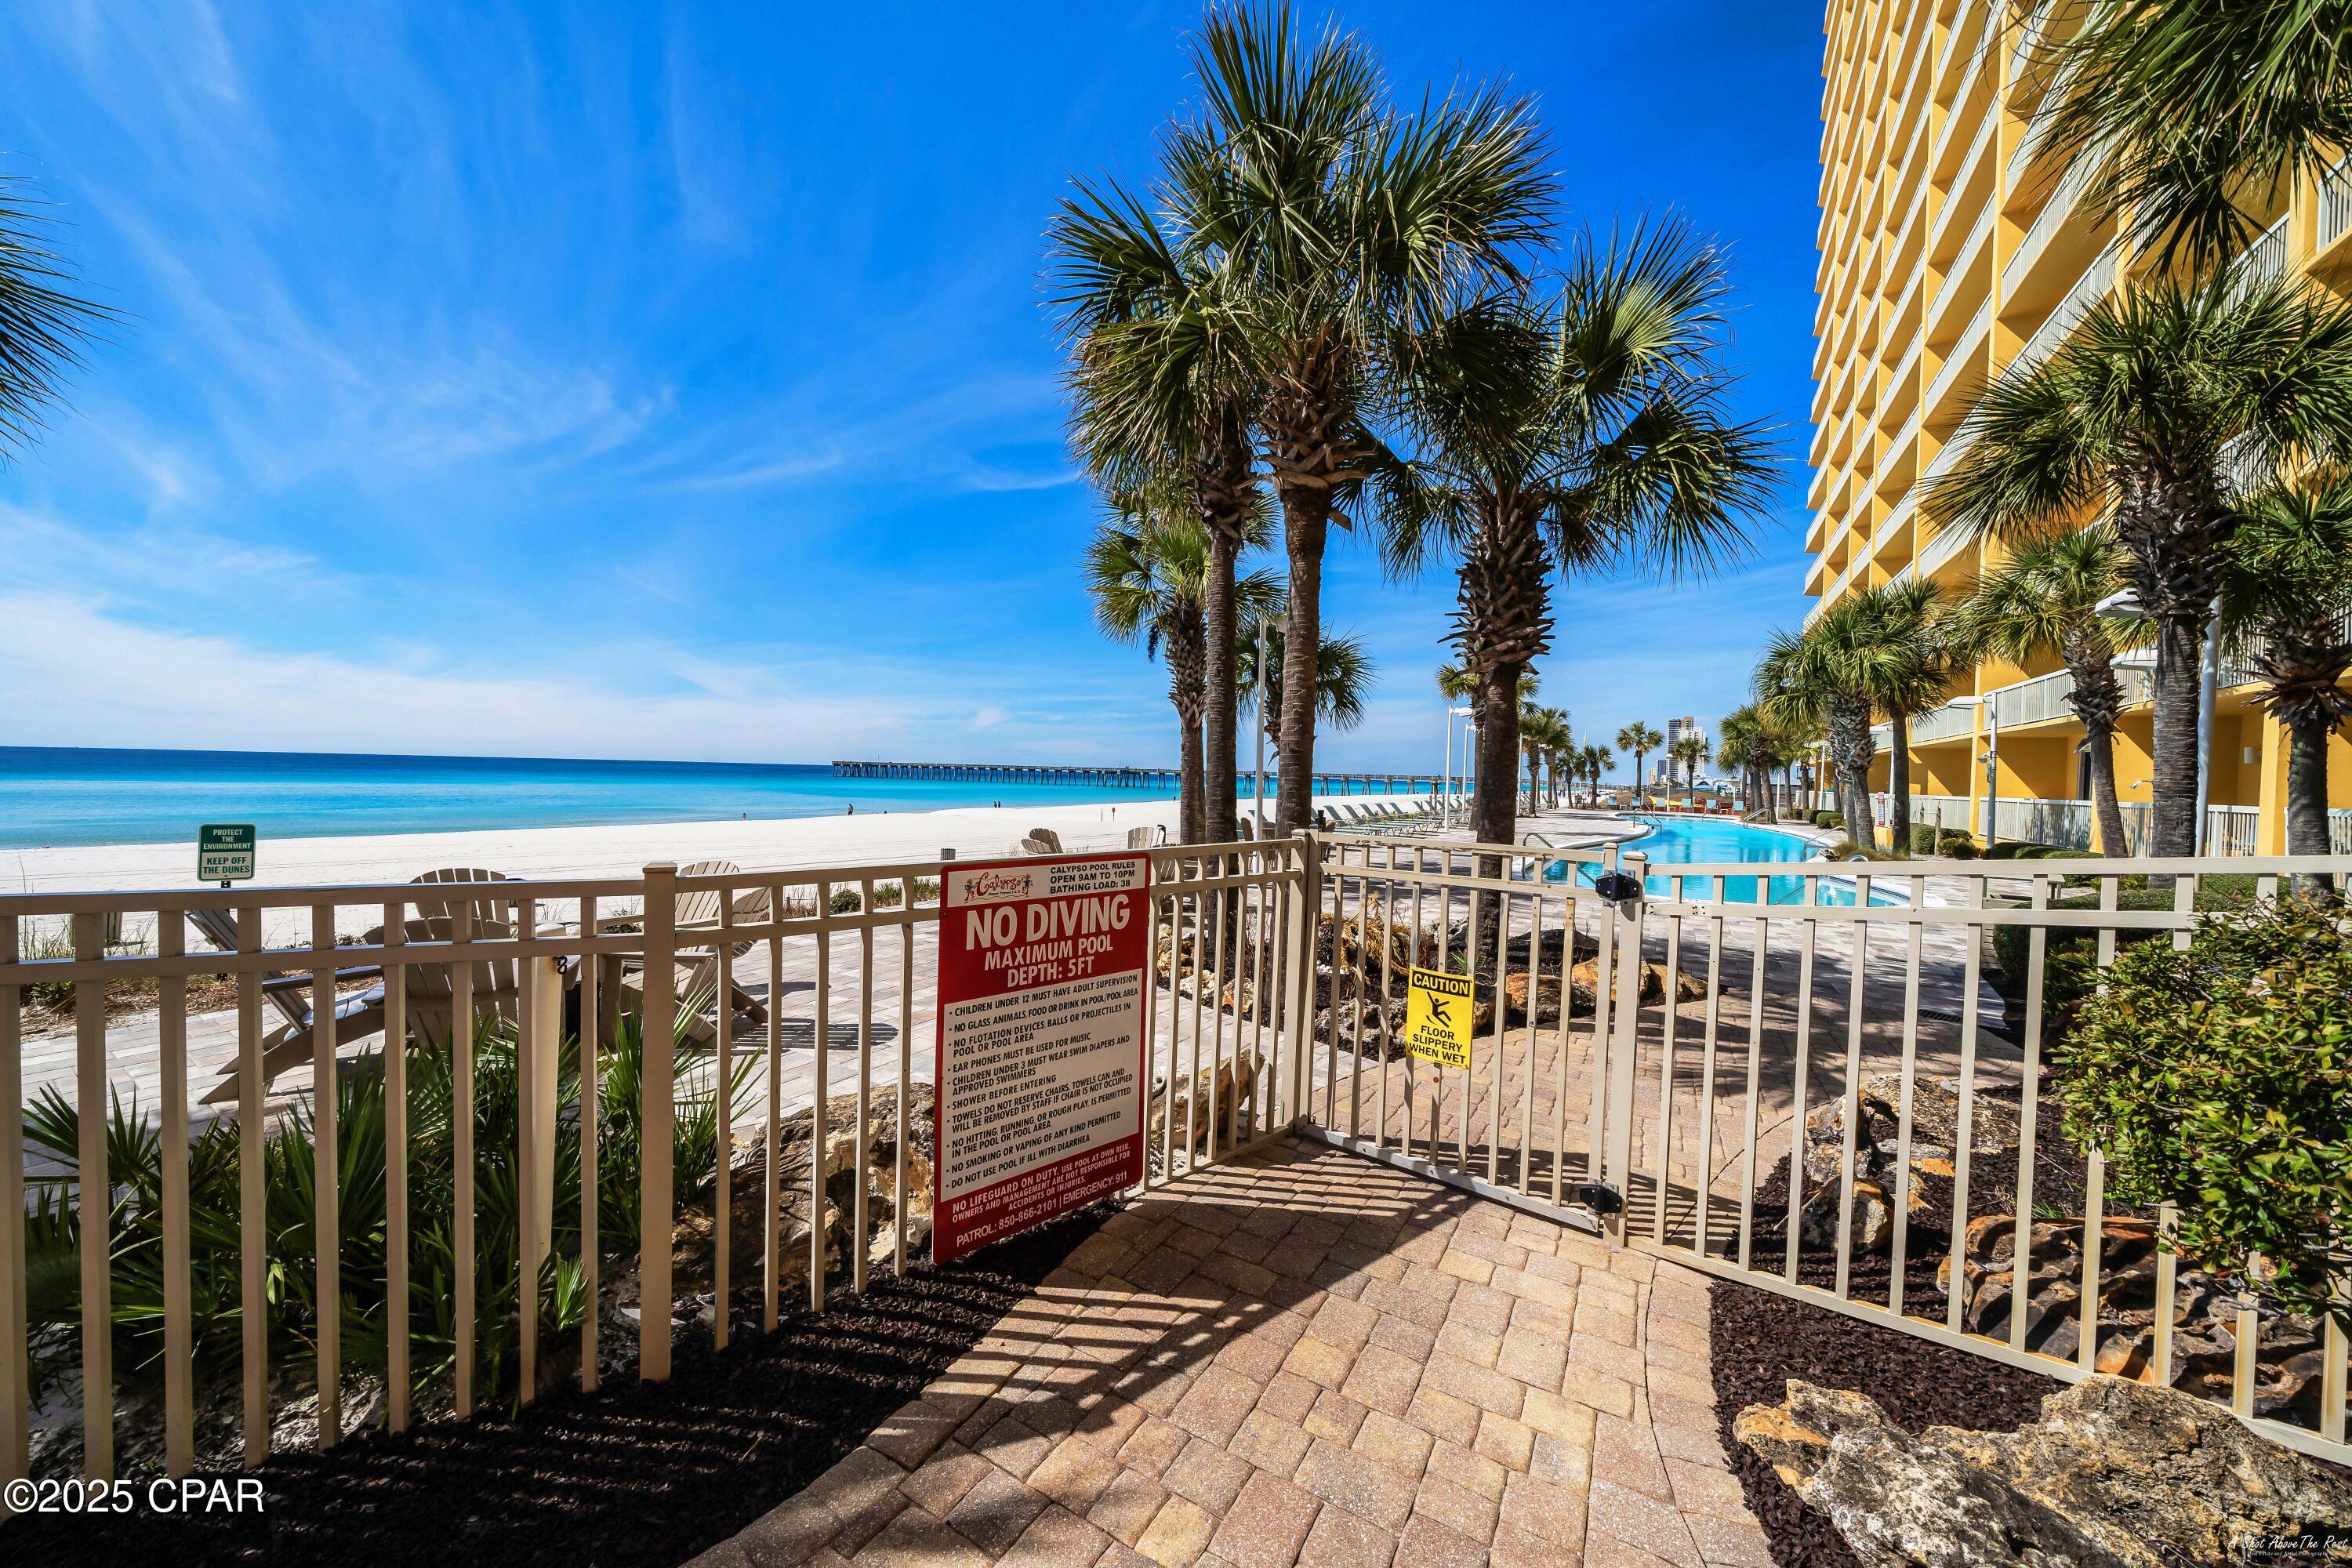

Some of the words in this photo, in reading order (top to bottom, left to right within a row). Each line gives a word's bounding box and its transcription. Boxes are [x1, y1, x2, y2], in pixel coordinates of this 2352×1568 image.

[1051, 875, 1075, 884] OPEN
[1051, 884, 1091, 894] BATHING
[967, 906, 1017, 950] NO
[1026, 895, 1130, 942] DIVING
[985, 940, 1073, 971] MAXIMUM
[1078, 935, 1112, 955] POOL
[1007, 962, 1062, 987] DEPTH:
[1068, 956, 1094, 976] 5FT
[955, 1002, 992, 1016] CHILDREN
[996, 997, 1019, 1008] UNDER
[1032, 990, 1051, 1001] MUST
[1054, 987, 1070, 997] HAVE
[1073, 982, 1094, 993] ADULT
[1096, 974, 1138, 989] SUPERVISION
[1414, 974, 1468, 994] CAUTION
[954, 1038, 966, 1048] NO
[969, 1029, 1011, 1044] FLOTATION
[1047, 1016, 1067, 1027] BALLS
[1082, 1004, 1121, 1019] PROJECTILES
[955, 1023, 965, 1033] NO
[1029, 1007, 1047, 1017] FOOD
[1059, 1000, 1079, 1011] DRINK
[1089, 991, 1122, 1004] POOL/POOL
[1123, 988, 1138, 997] AREA
[953, 1062, 968, 1073] EAR
[971, 1054, 1001, 1068] PHONES
[1004, 1048, 1023, 1061] MUST
[1025, 1047, 1034, 1055] BE
[1036, 1040, 1053, 1052] USED
[1056, 1038, 1068, 1047] FOR
[1070, 1033, 1091, 1044] MUSIC
[1413, 1034, 1463, 1052] SLIPPERY
[1421, 1025, 1454, 1040] FLOOR
[953, 1069, 991, 1086] CHILDREN
[993, 1062, 1018, 1076] UNDER
[1027, 1055, 1047, 1068] MUST
[1048, 1051, 1067, 1062] WEAR
[1069, 1045, 1087, 1057] SWIM
[1090, 1039, 1115, 1051] DIAPERS
[1116, 1036, 1130, 1044] AND
[1409, 1043, 1438, 1058] WHEN
[1443, 1051, 1465, 1064] WET
[953, 1079, 994, 1096] APPROVED
[996, 1067, 1036, 1084] SWIMMERS
[953, 1094, 986, 1109] SHOWER
[989, 1085, 1018, 1099] BEFORE
[1021, 1075, 1056, 1091] ENTERING
[953, 1108, 982, 1123] TOWELS
[985, 1105, 995, 1115] DO
[997, 1100, 1012, 1111] NOT
[1014, 1091, 1044, 1106] RESERVE
[1073, 1076, 1095, 1089] TOWELS
[1098, 1072, 1110, 1081] CAN
[1112, 1069, 1124, 1077] AND
[953, 1121, 971, 1134] WILL
[973, 1118, 982, 1128] BE
[985, 1107, 1019, 1124] REMOVED
[1022, 1104, 1030, 1113] BY
[1032, 1097, 1052, 1110] STAFF
[1054, 1094, 1059, 1103] IF
[1062, 1089, 1080, 1101] CHAIR
[1090, 1083, 1102, 1093] NOT
[1104, 1074, 1133, 1088] OCCUPIED
[953, 1138, 964, 1149] NO
[1037, 1112, 1047, 1122] OR
[1049, 1106, 1071, 1119] ROUGH
[1098, 1087, 1131, 1103] PERMITTED
[952, 1163, 963, 1174] NO
[966, 1150, 1001, 1169] SMOKING
[1004, 1146, 1013, 1156] OR
[1015, 1137, 1042, 1152] VAPING
[1044, 1133, 1052, 1142] OF
[1054, 1129, 1068, 1139] ANY
[1070, 1123, 1085, 1134] KIND
[1087, 1111, 1121, 1128] PERMITTED
[953, 1149, 960, 1159] IN
[964, 1143, 977, 1155] THE
[980, 1137, 999, 1149] POOL
[1001, 1133, 1011, 1142] OR
[1013, 1127, 1031, 1139] POOL
[1033, 1120, 1051, 1132] AREA
[952, 1178, 963, 1189] DO
[965, 1171, 981, 1184] NOT
[983, 1166, 996, 1177] USE
[998, 1159, 1017, 1172] POOL
[1019, 1156, 1025, 1165] IF
[1027, 1152, 1036, 1162] ILL
[1039, 1145, 1055, 1158] WITH
[1058, 1134, 1090, 1151] DIARRHEA
[953, 1200, 966, 1214] NO
[970, 1182, 1018, 1207] LIFEGUARD
[1021, 1175, 1033, 1187] ON
[1036, 1167, 1059, 1182] DUTY.
[1062, 1163, 1073, 1173] USE
[1075, 1157, 1090, 1168] POOL
[1101, 1149, 1114, 1158] OWN
[1116, 1143, 1131, 1152] RISK.
[953, 1205, 983, 1223] OWNERS
[985, 1200, 1000, 1210] AND
[1003, 1181, 1050, 1204] MANAGEMENT
[1052, 1175, 1064, 1185] ARE
[1066, 1170, 1078, 1180] NOT
[1080, 1156, 1118, 1174] RESPONSIBLE
[1120, 1151, 1131, 1160] FOR
[1008, 1191, 1044, 1210] ACCIDENTS
[1046, 1187, 1054, 1196] OR
[1057, 1176, 1085, 1192] INJURIES.
[956, 1224, 996, 1247] PATROL:
[999, 1200, 1057, 1229] 850-866-2101
[1063, 1177, 1114, 1203] EMERGENCY:
[1116, 1171, 1127, 1183] 911
